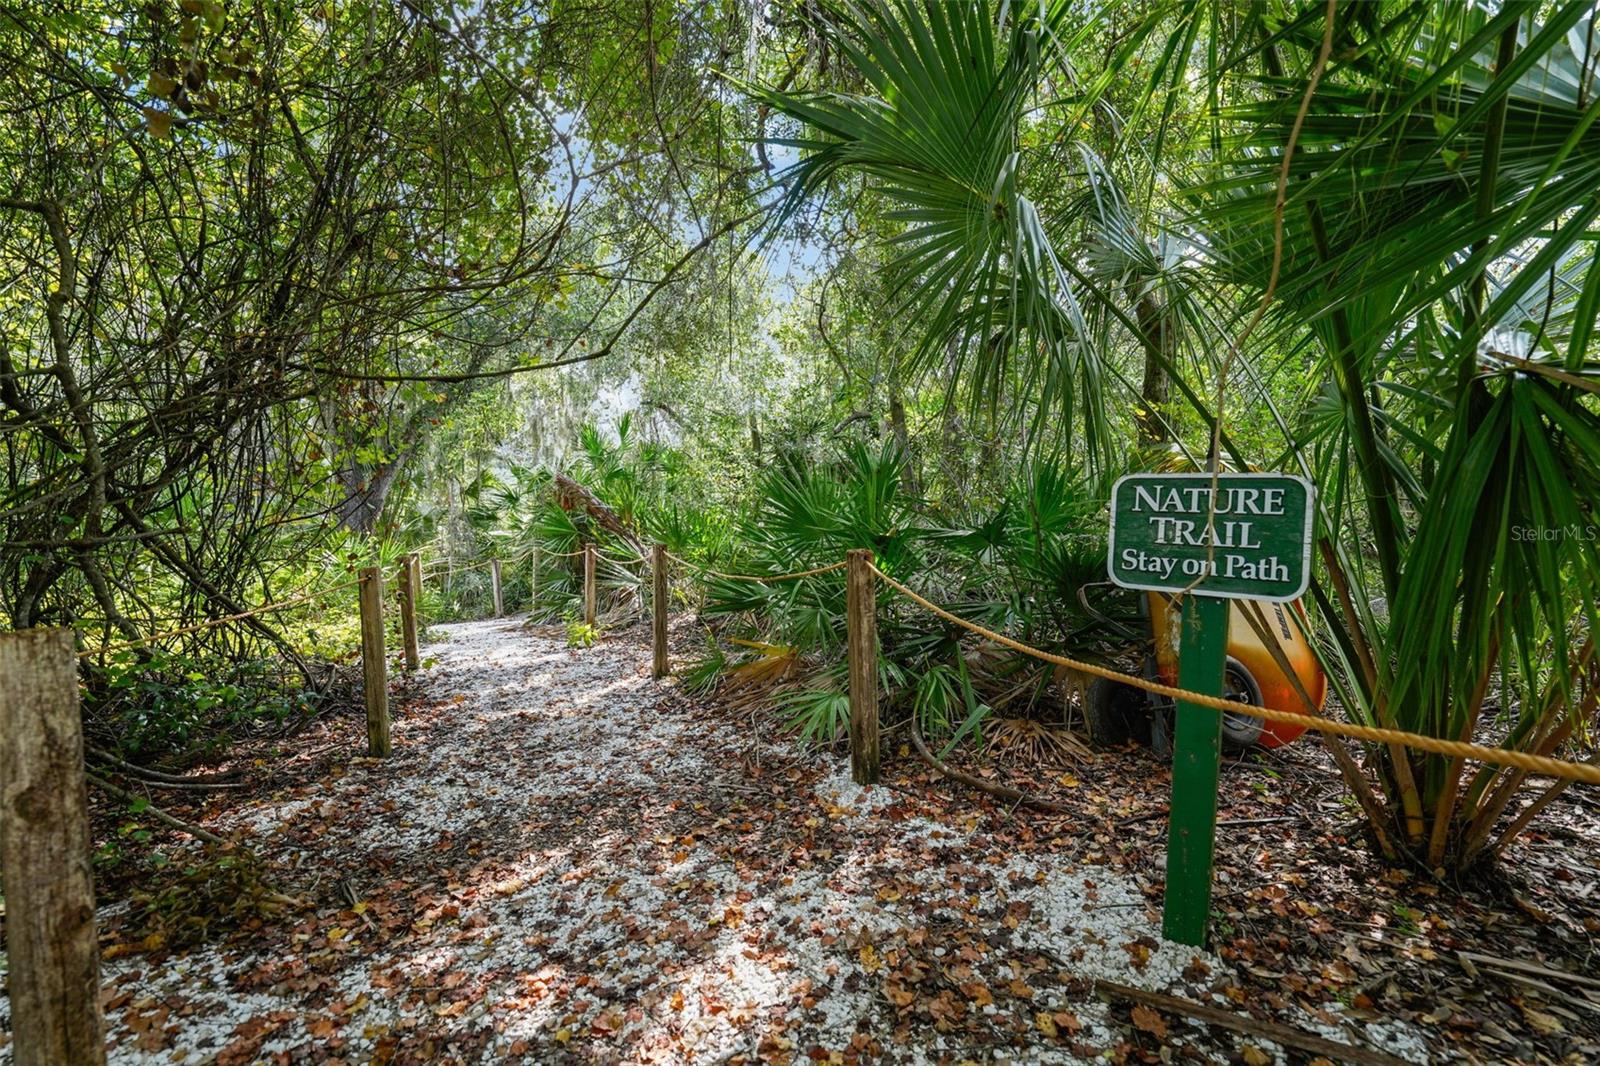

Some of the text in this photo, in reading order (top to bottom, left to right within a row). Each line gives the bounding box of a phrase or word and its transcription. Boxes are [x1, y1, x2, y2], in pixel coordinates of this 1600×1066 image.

[1131, 485, 1285, 515] NATURE
[1149, 516, 1261, 548] TRAIL
[1121, 549, 1290, 582] Stay on Path
